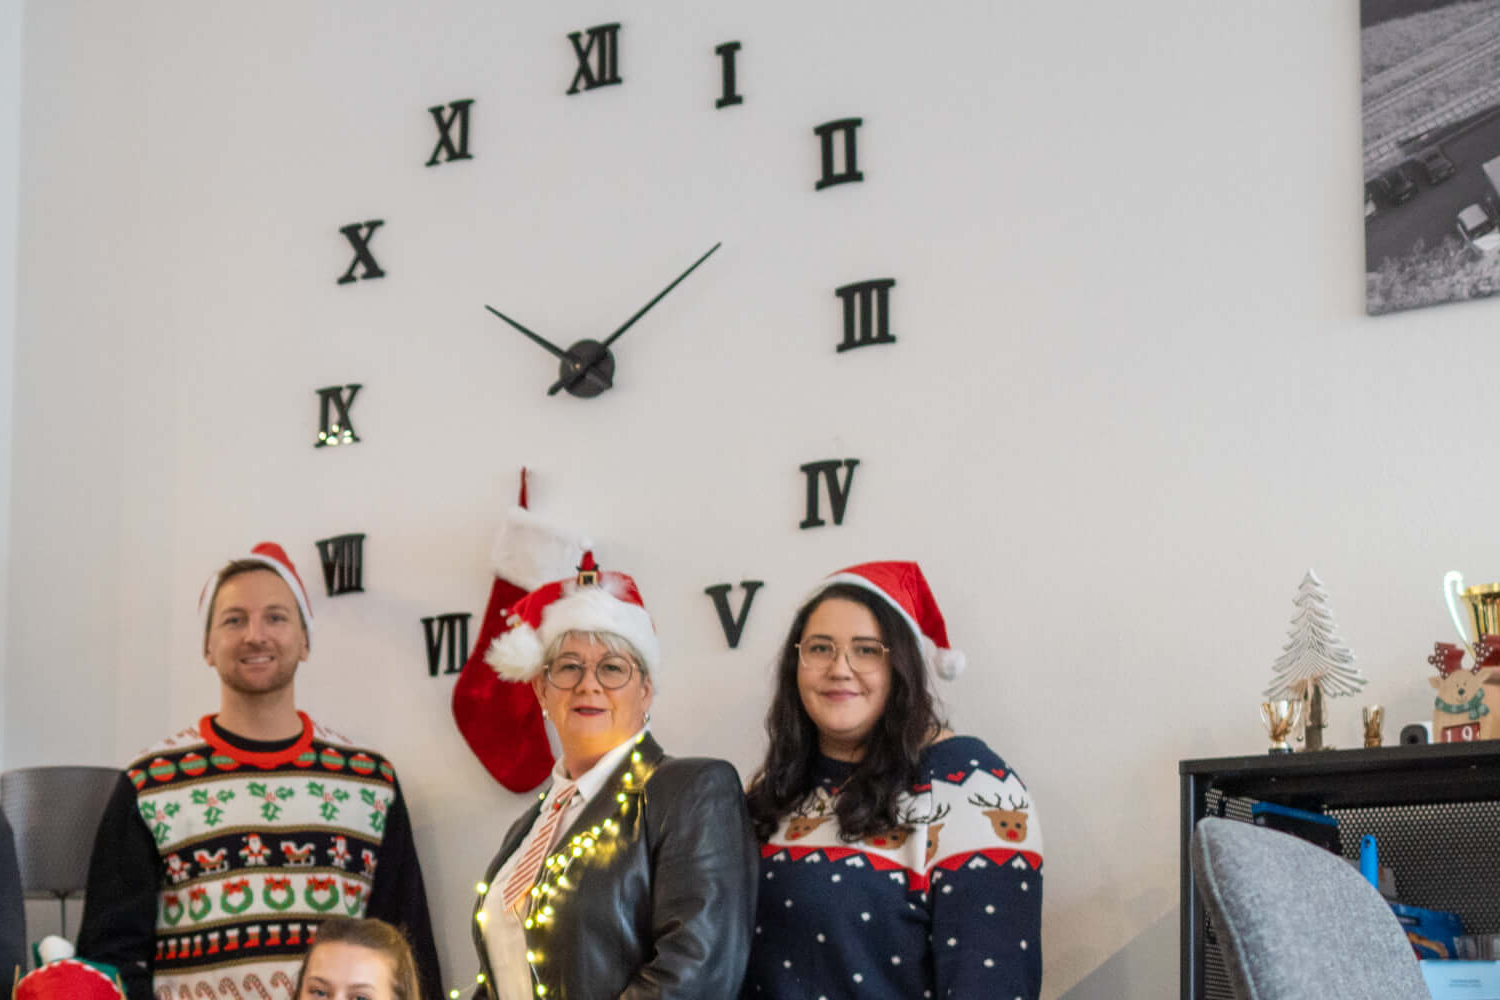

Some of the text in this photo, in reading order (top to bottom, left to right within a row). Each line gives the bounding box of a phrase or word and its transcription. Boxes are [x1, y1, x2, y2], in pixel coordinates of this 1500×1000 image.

[567, 23, 622, 95] XII
[715, 41, 743, 109] I
[426, 99, 474, 167] XI
[814, 117, 864, 191] II
[338, 220, 385, 285] X
[835, 279, 896, 353] III
[314, 384, 362, 448] IX
[800, 459, 860, 530] IV
[316, 533, 366, 597] VIII
[421, 612, 472, 677] VII
[705, 581, 764, 649] V
